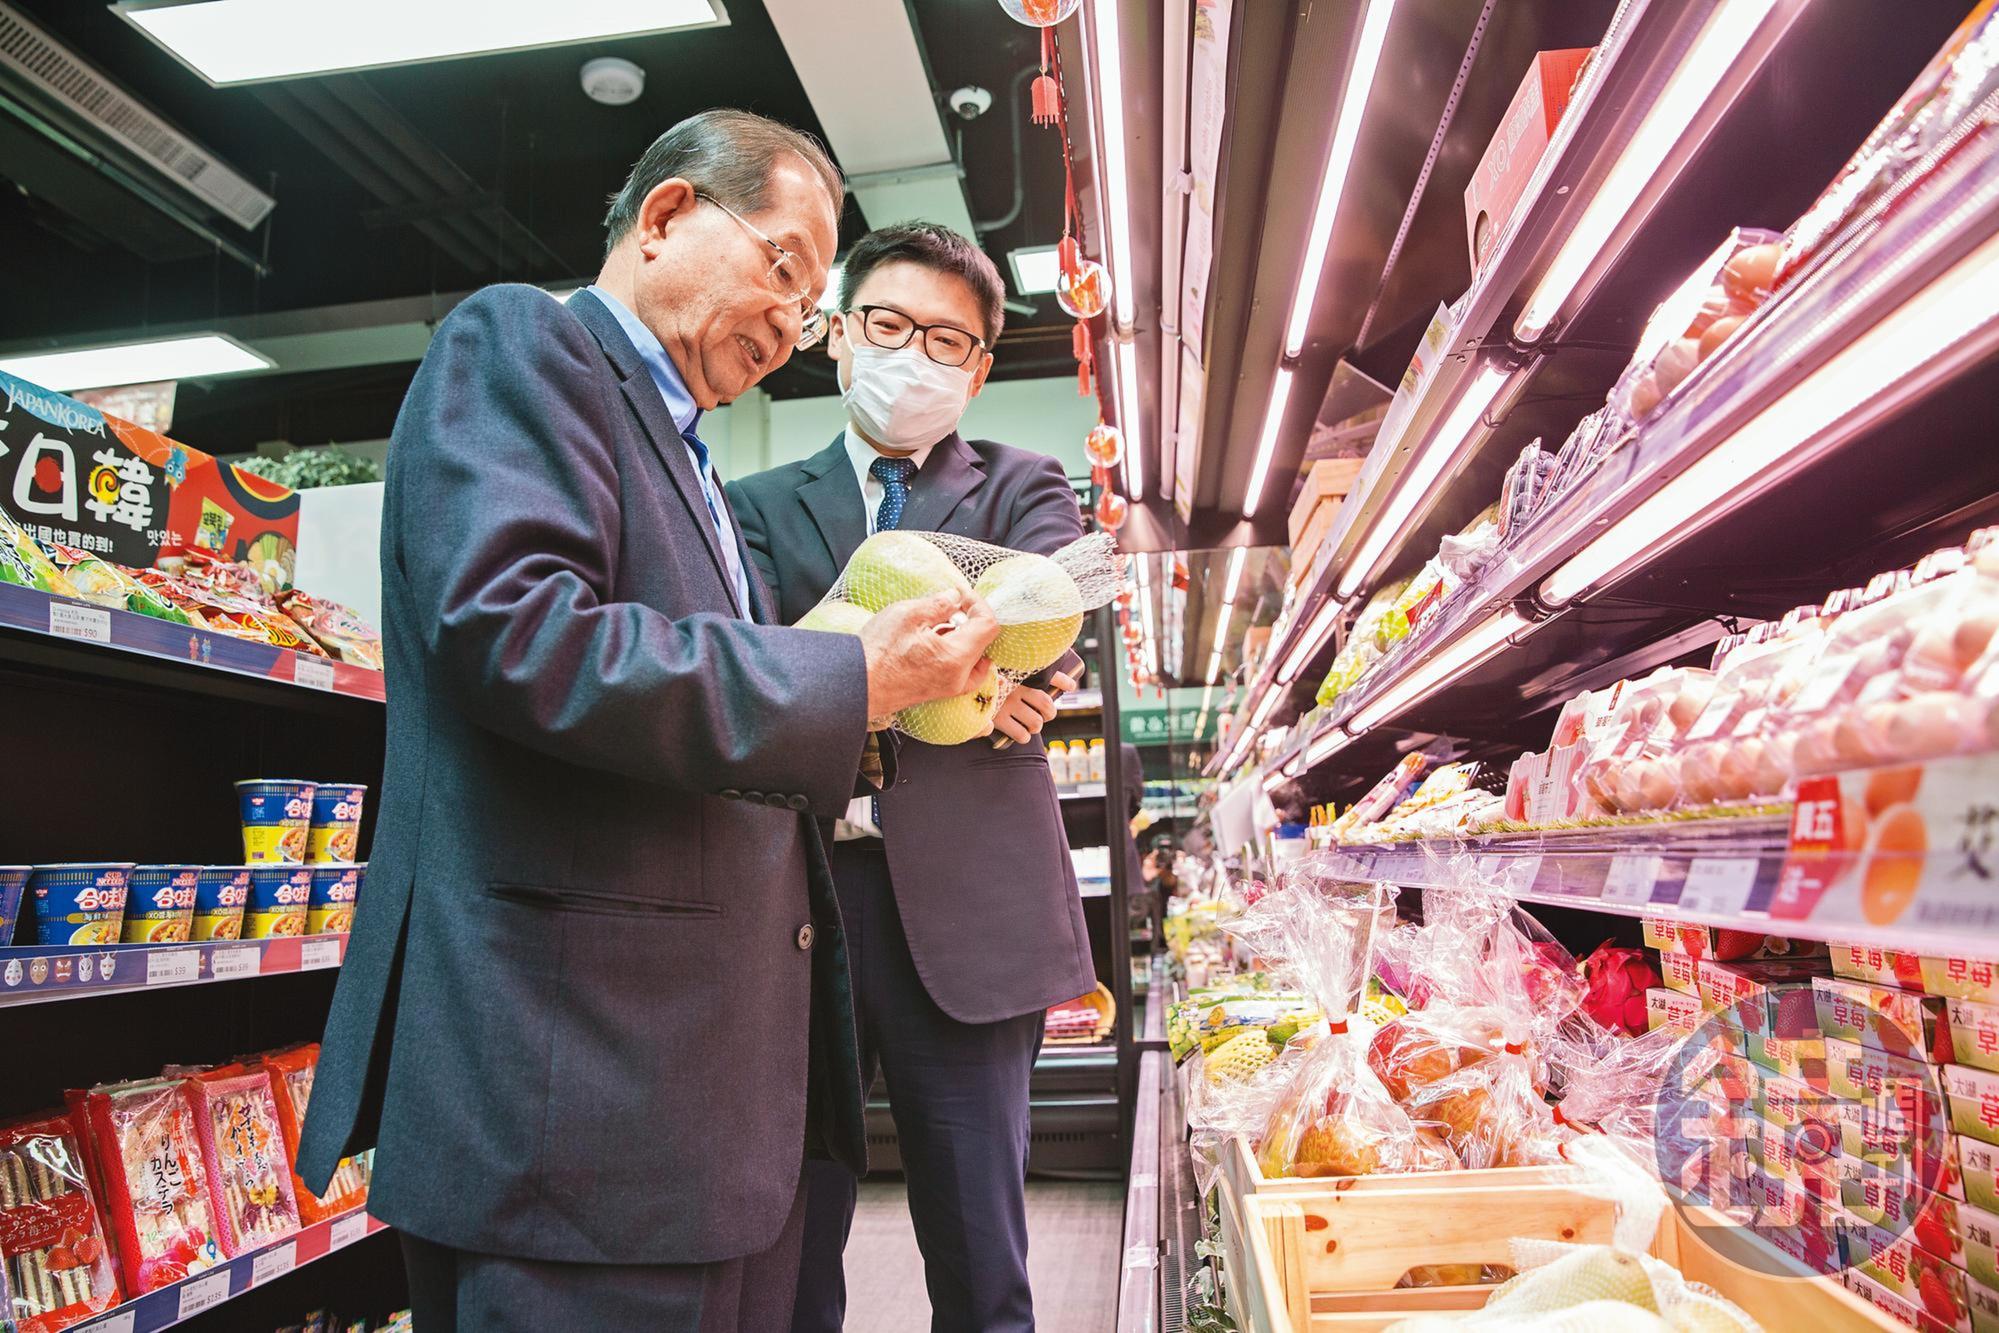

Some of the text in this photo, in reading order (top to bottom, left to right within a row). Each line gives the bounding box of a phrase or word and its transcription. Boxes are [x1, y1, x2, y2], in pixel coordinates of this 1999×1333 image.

[0, 418, 154, 532] 日韓
[19, 522, 114, 553] 出國也買的到!
[1672, 959, 1692, 985] 草莓
[1712, 979, 1733, 1011] 草莓
[1834, 997, 1867, 1032] 草莓
[1848, 1058, 1883, 1096] 草莓
[1767, 1087, 1796, 1121] 草莓
[160, 1134, 182, 1188] りんご
[1763, 1136, 1793, 1171] 草莓
[150, 1156, 174, 1216] カステラ
[1864, 1179, 1902, 1222] 草莓
[1967, 1223, 1992, 1247] 大湖
[1869, 1237, 1907, 1284] 草莓
